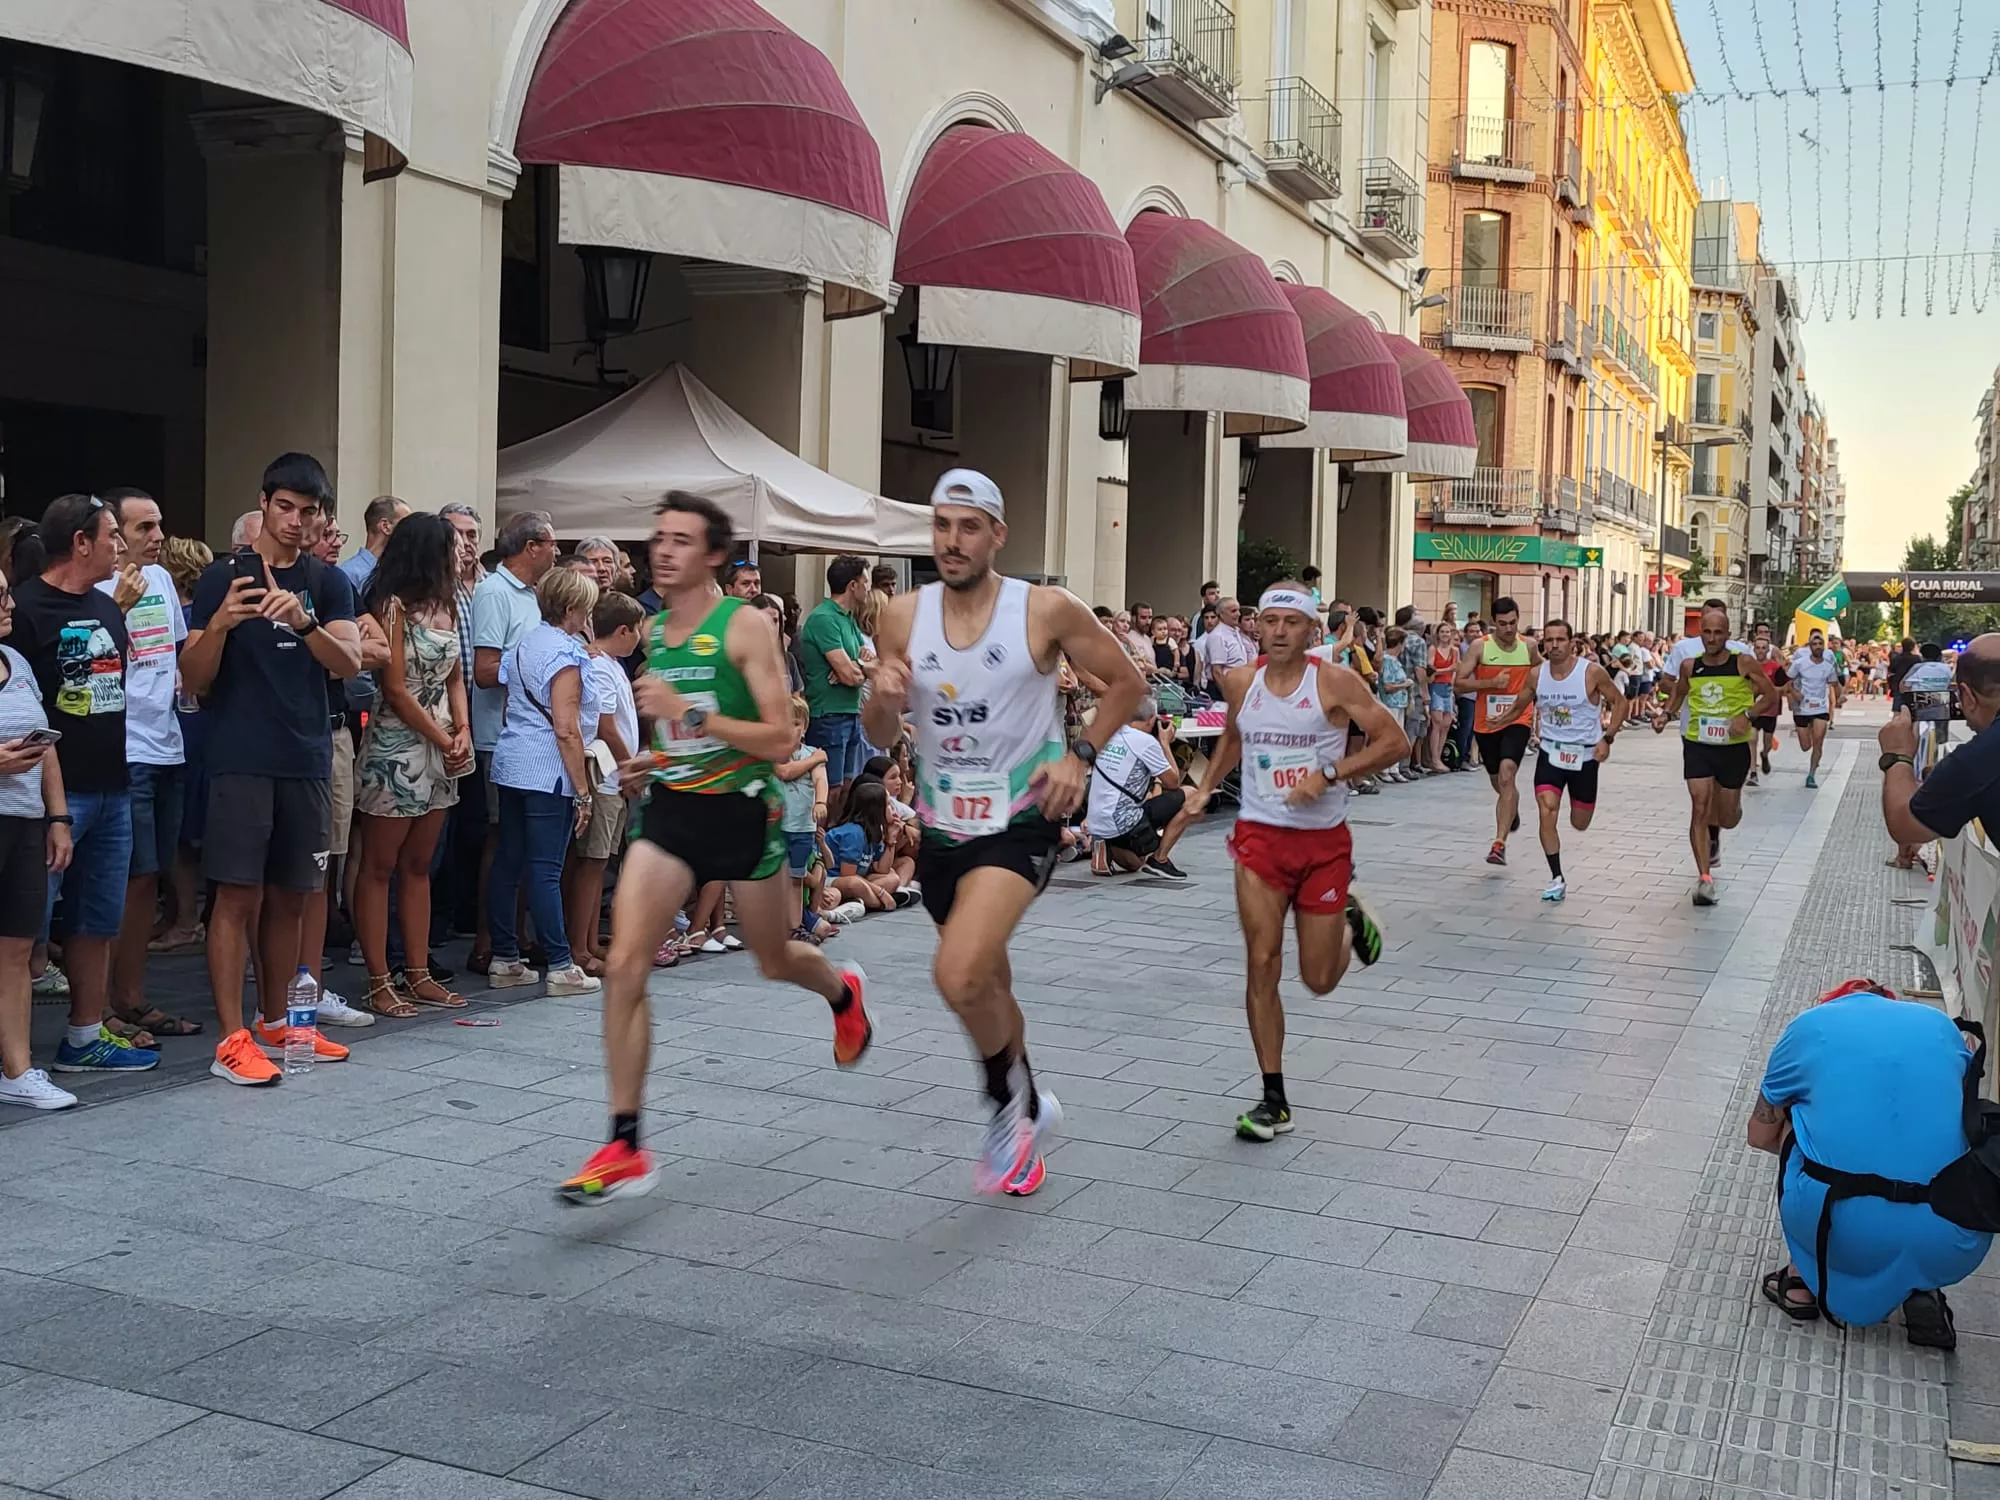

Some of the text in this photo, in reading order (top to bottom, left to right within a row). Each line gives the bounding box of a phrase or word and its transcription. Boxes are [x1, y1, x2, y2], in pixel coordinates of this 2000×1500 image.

[1910, 580, 1984, 591] CAJA RURAL
[1933, 591, 1975, 600] ARAGÓN
[931, 703, 989, 727] SYB
[1707, 726, 1725, 737] 070
[1559, 751, 1578, 764] 002
[952, 795, 992, 820] 072
